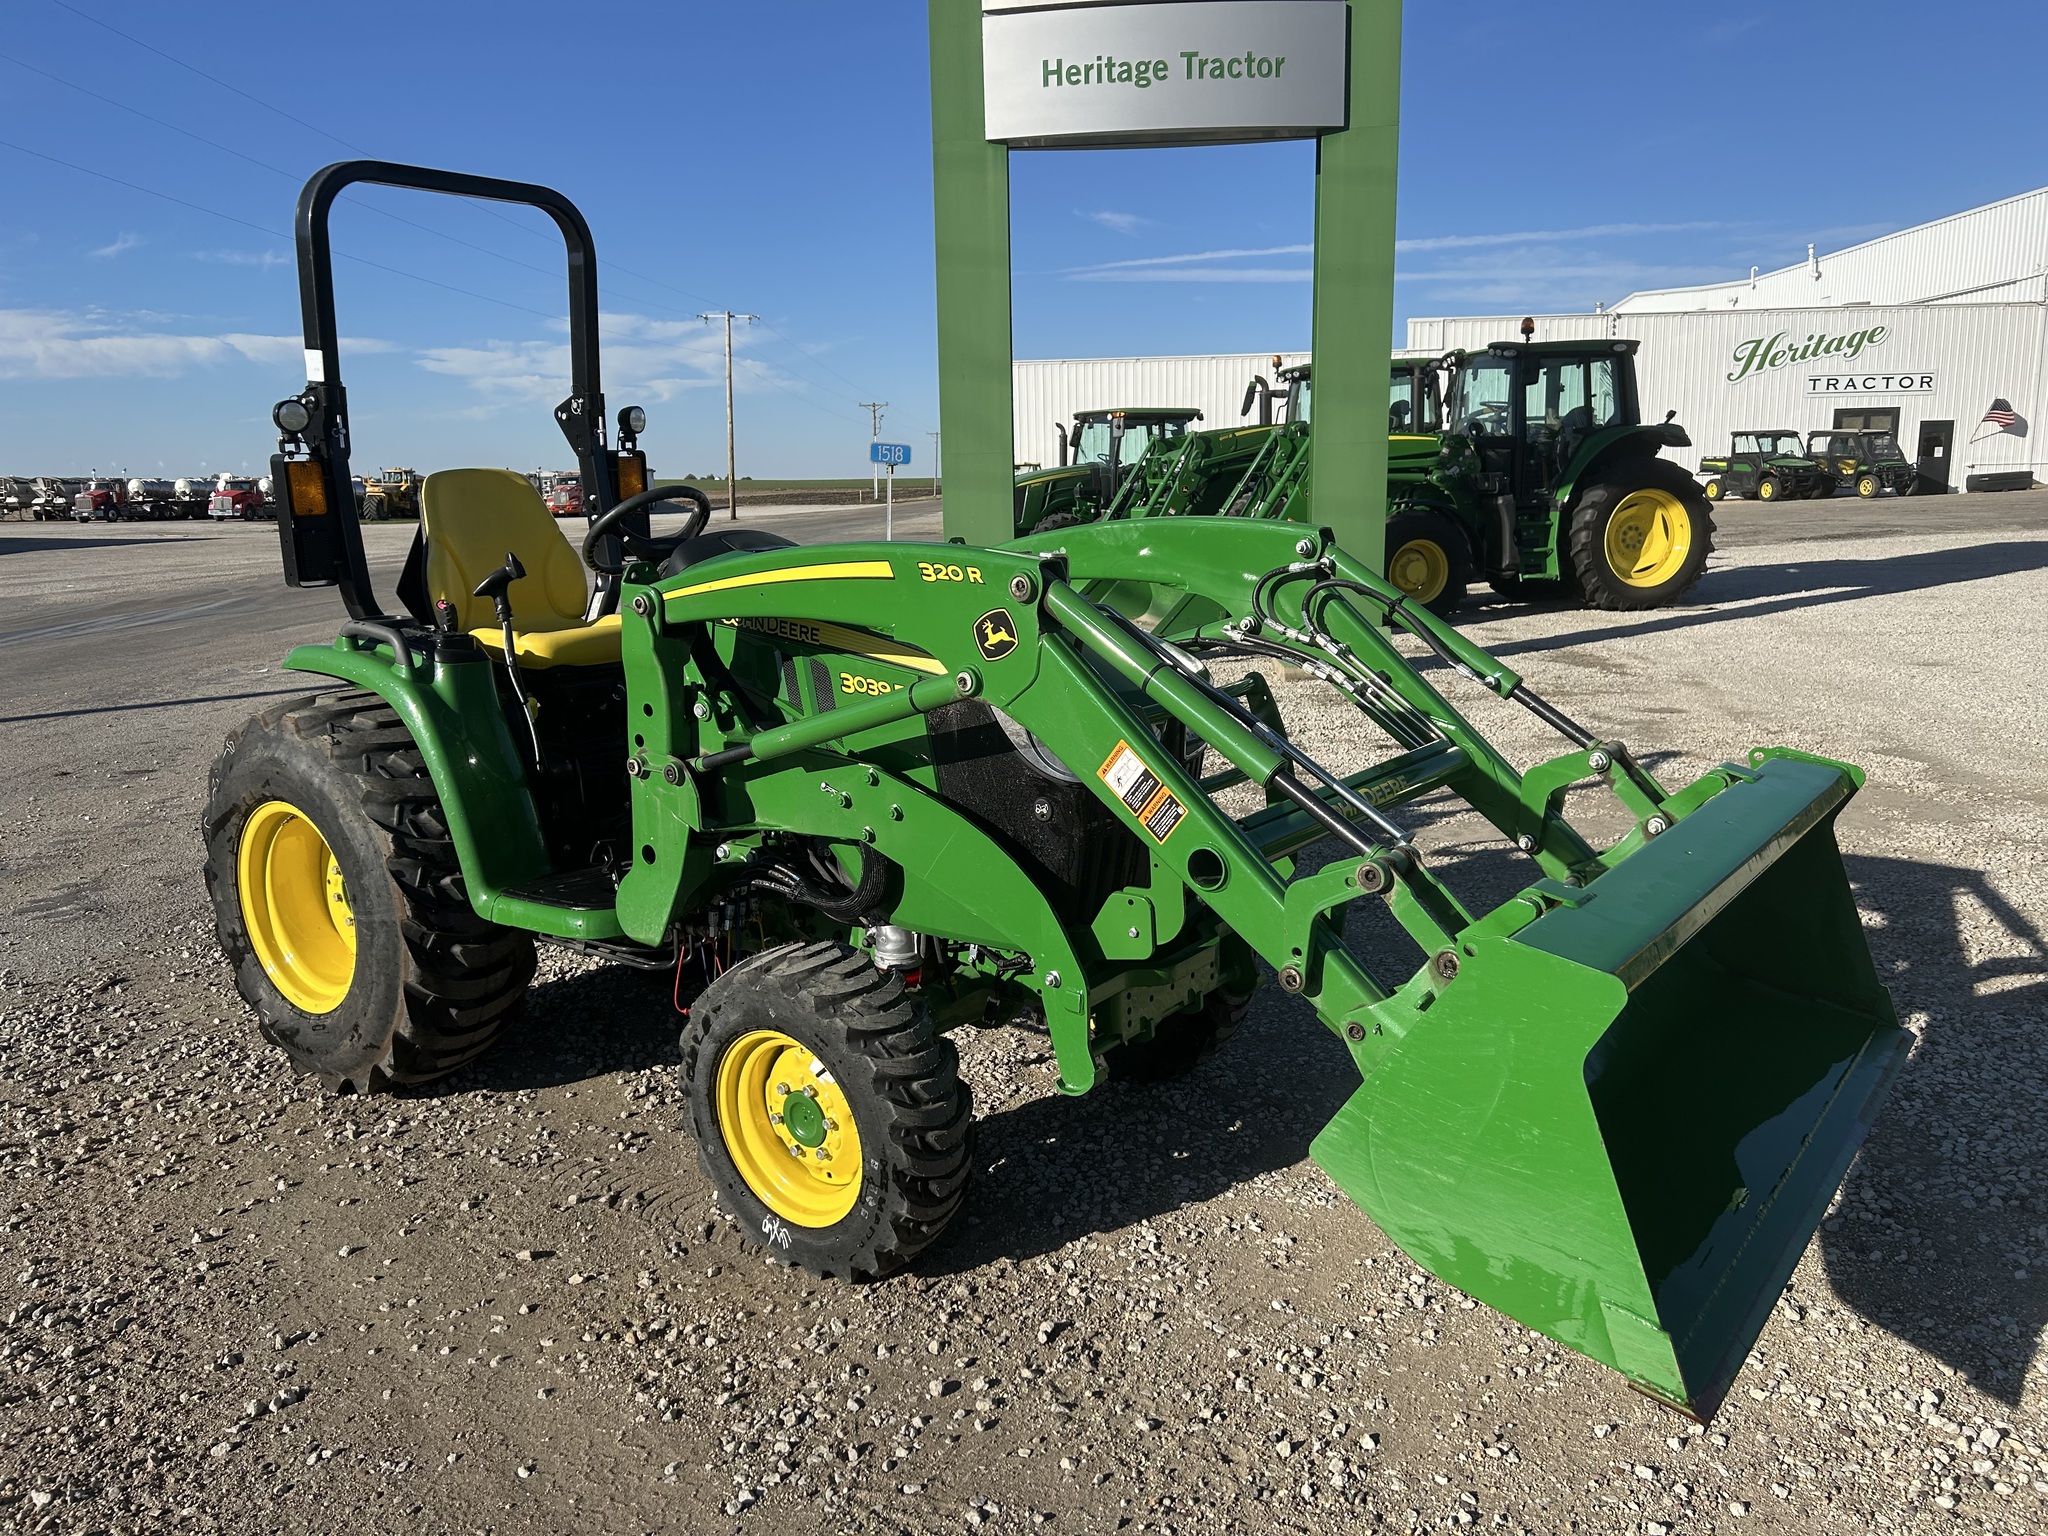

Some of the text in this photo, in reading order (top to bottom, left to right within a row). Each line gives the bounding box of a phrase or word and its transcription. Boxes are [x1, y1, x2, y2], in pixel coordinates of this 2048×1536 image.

[1042, 51, 1286, 89] Heritage Tractor
[1727, 324, 1887, 382] Heritage
[1808, 375, 1934, 391] TRACTOR
[877, 445, 904, 462] 1518
[917, 561, 986, 585] 320 R
[765, 618, 821, 645] DEERE
[839, 672, 892, 697] 3039
[1105, 745, 1124, 769] WARNING
[1147, 791, 1167, 815] WARNING
[1358, 774, 1408, 808] DEERE
